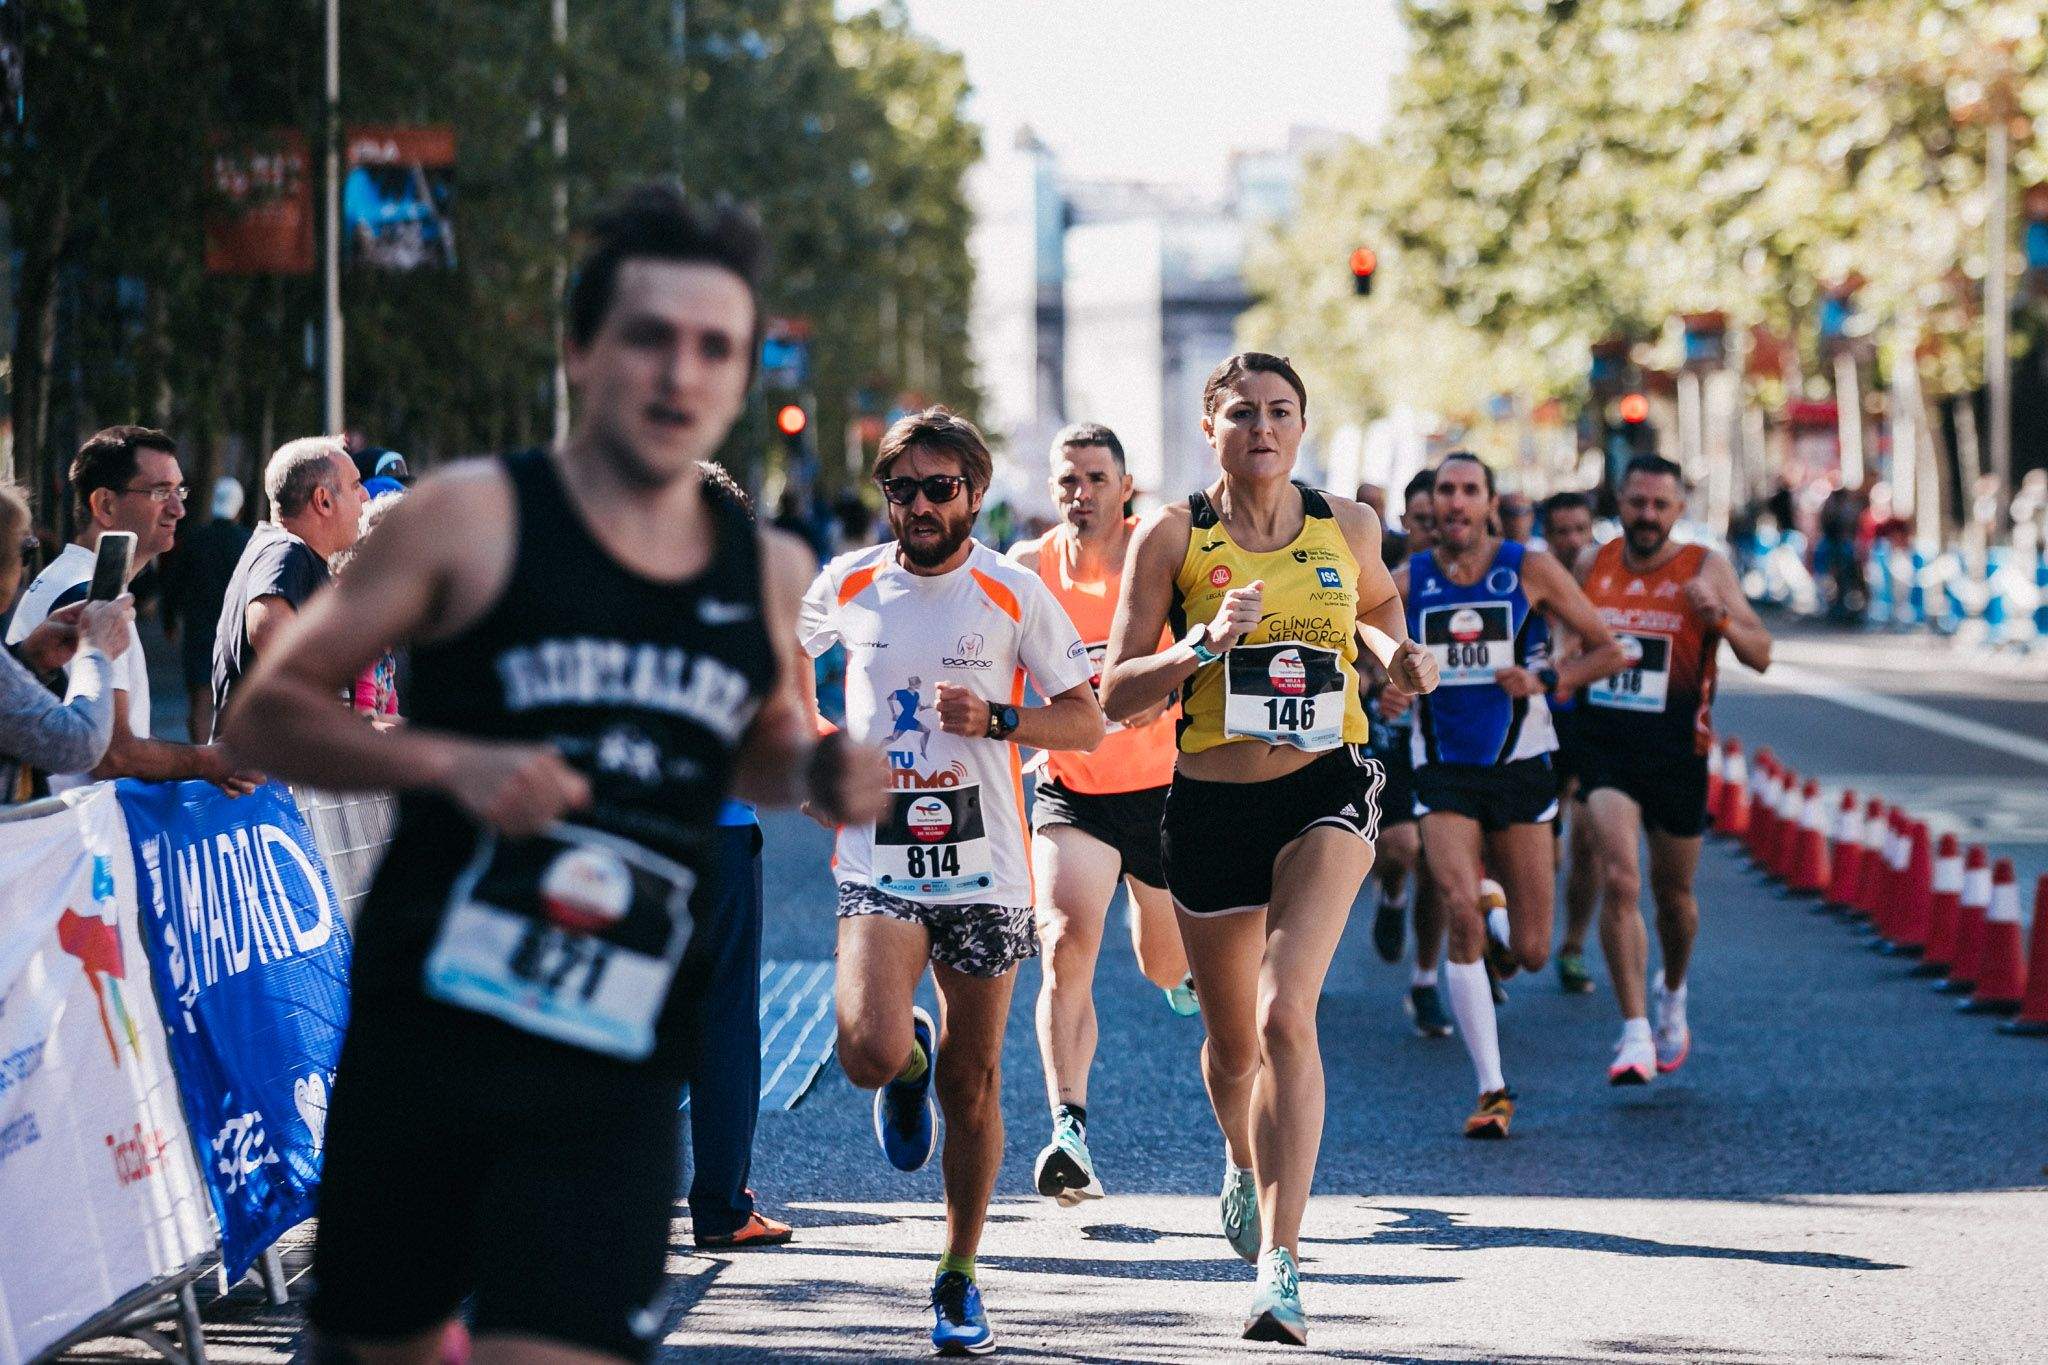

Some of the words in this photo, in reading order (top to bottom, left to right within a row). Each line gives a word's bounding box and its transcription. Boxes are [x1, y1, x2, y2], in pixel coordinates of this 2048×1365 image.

[1320, 571, 1339, 583] ISC
[1309, 591, 1352, 602] AVODENT
[1269, 616, 1332, 632] CLÍNICA
[1268, 630, 1347, 646] MENORCA
[1447, 641, 1489, 668] 800
[1263, 698, 1316, 731] 146
[887, 750, 914, 769] TU
[890, 768, 960, 789] ITMO
[907, 844, 961, 879] 814
[176, 823, 333, 994] MADRID
